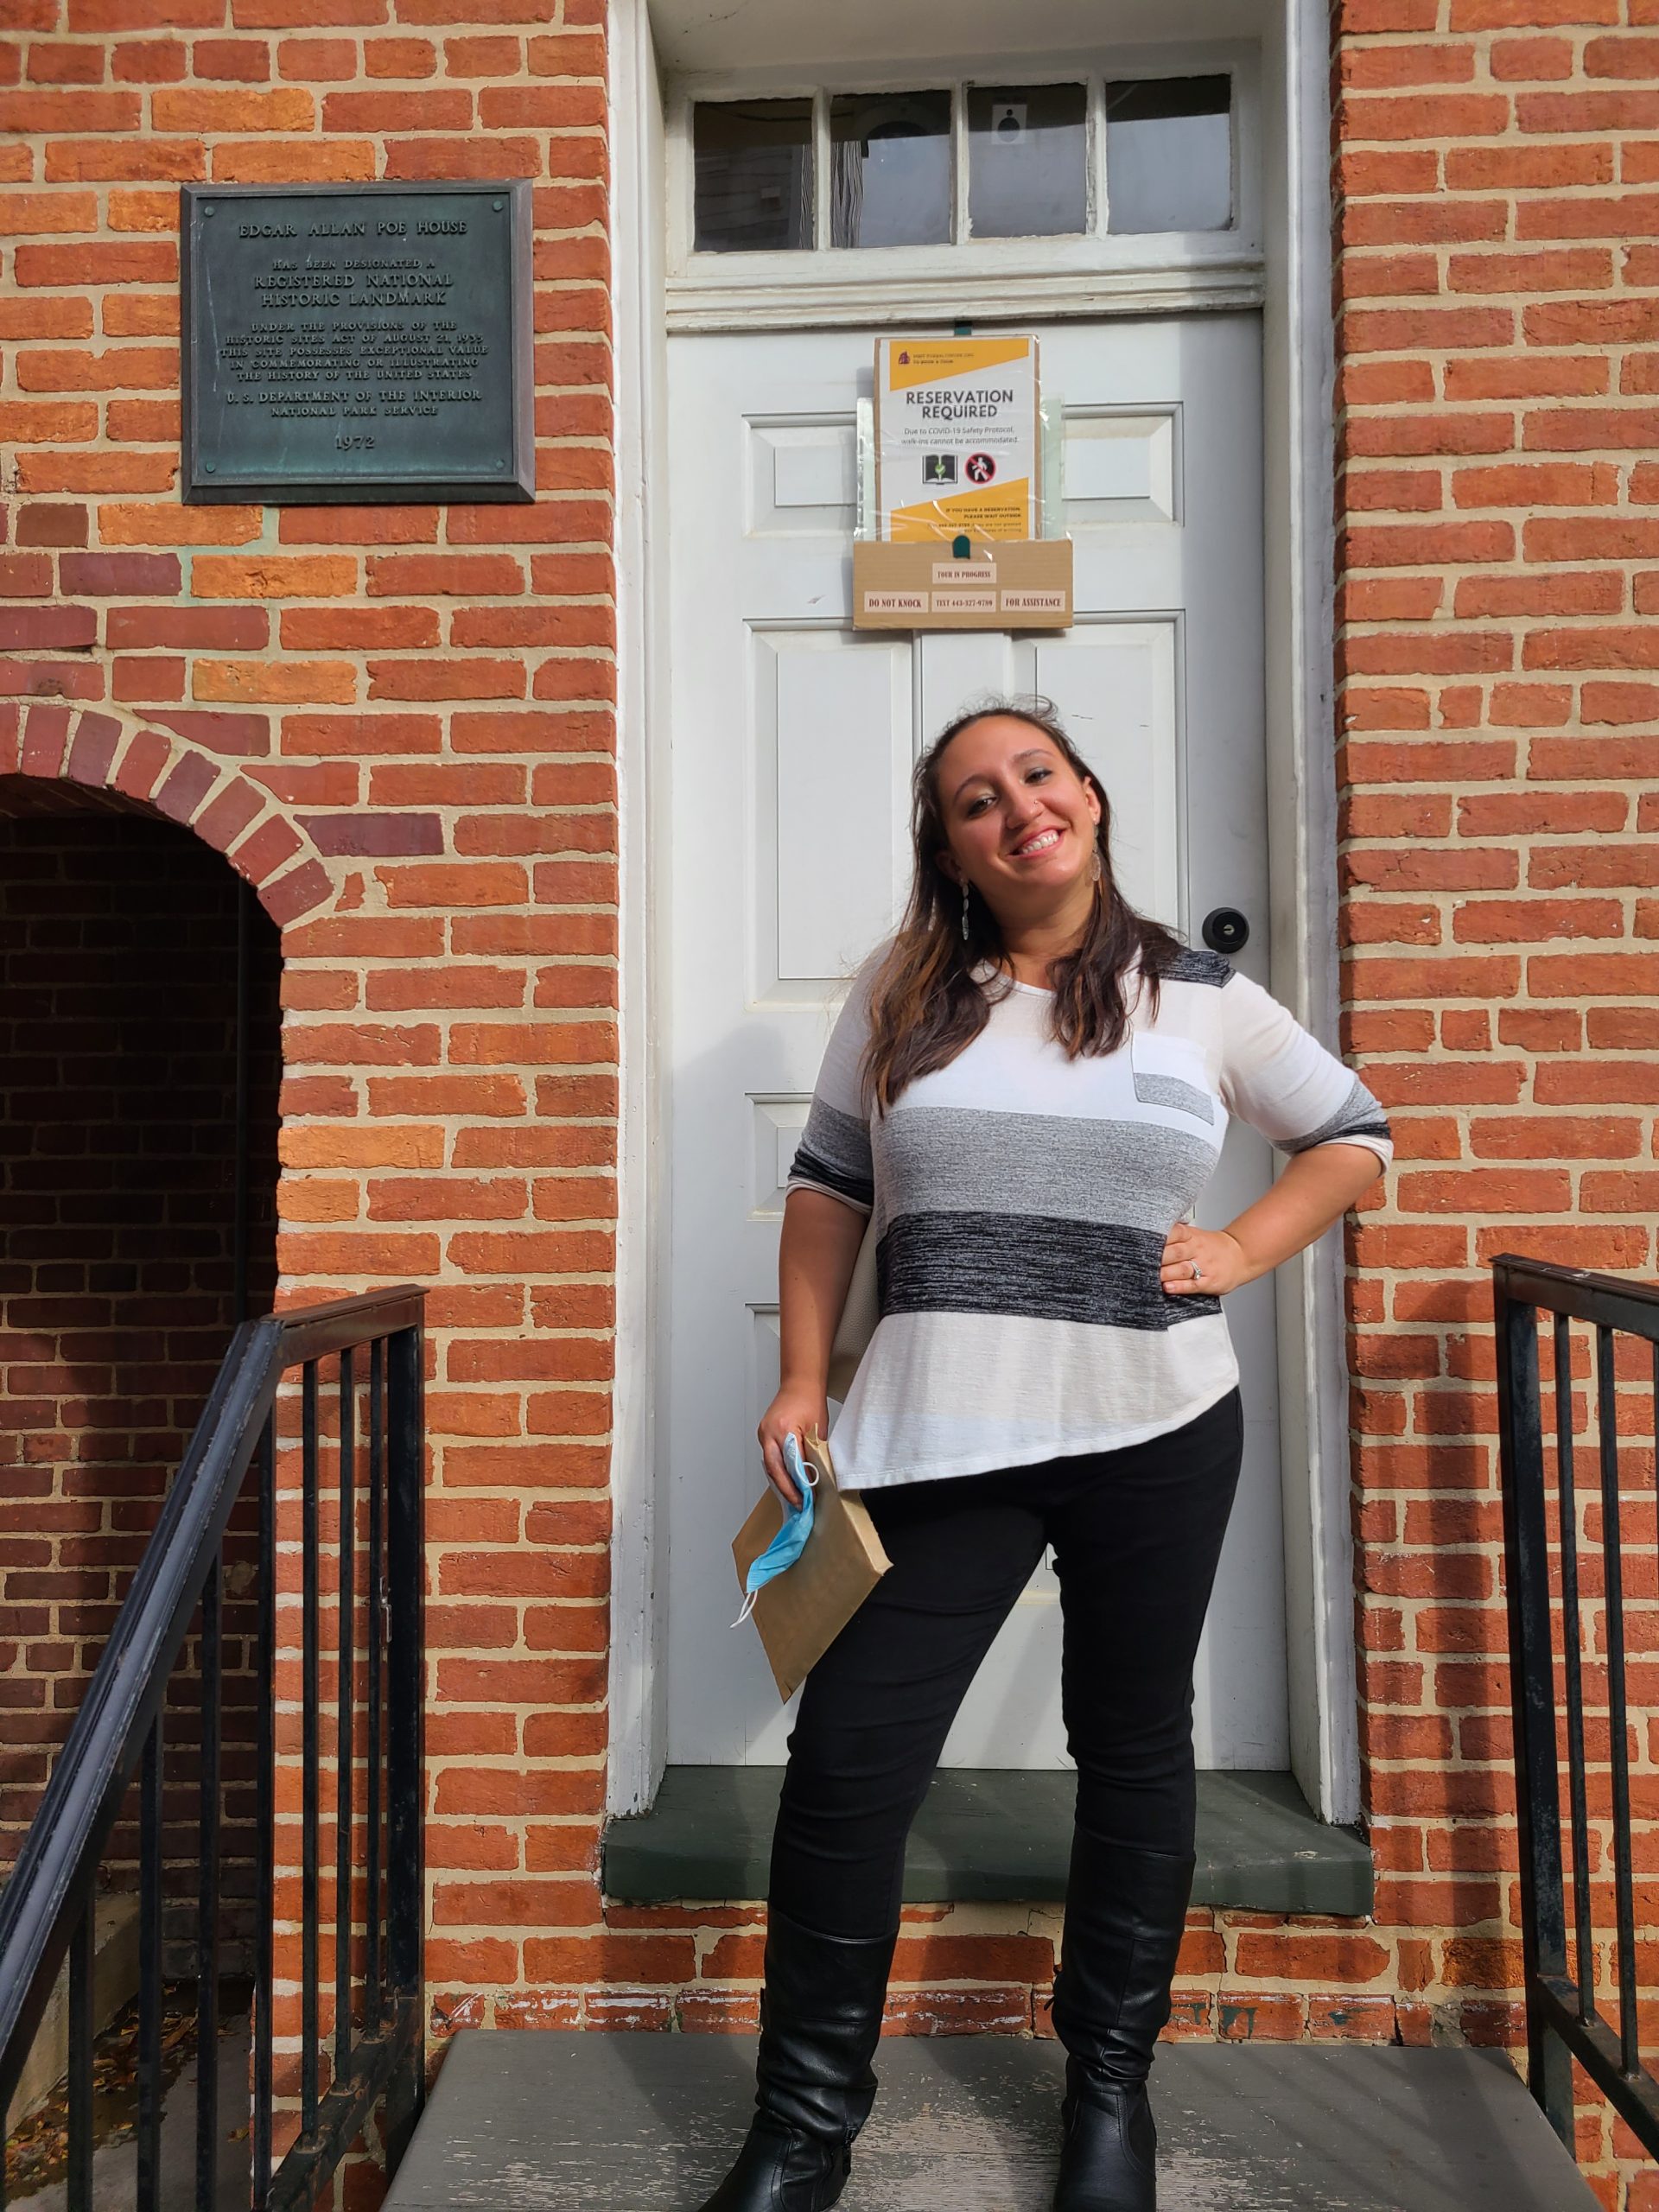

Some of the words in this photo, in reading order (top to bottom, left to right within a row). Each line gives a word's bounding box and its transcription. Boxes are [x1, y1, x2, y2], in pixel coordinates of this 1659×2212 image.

[239, 224, 297, 238] EDGAR
[308, 222, 365, 236] ALLAN
[377, 221, 407, 235] POE
[416, 220, 467, 234] HOUSE
[273, 260, 298, 270] HAS
[306, 260, 336, 270] BEEN
[426, 258, 435, 269] A
[255, 275, 355, 289] REGISTERED
[366, 272, 454, 288] NATIONAL
[262, 293, 340, 307] HISTORIC
[349, 290, 446, 306] LANDMARK
[251, 322, 295, 333] UNDER
[302, 321, 325, 332] THE
[333, 321, 404, 332] PROVISIONS
[411, 321, 427, 330] OF
[434, 321, 457, 330] THE
[226, 335, 283, 346] HISTORIC
[292, 334, 325, 343] SITES
[332, 334, 355, 344] ACT
[362, 334, 376, 342] OF
[384, 334, 430, 343] AUGUST
[220, 347, 248, 358] THIS
[256, 347, 282, 358] SITE
[290, 346, 353, 356] POSSESSES
[359, 346, 443, 355] EXCEPTIONAL
[449, 346, 488, 355] VALUE
[230, 361, 243, 370] IN
[251, 359, 360, 369] COMMEMORATING
[367, 359, 384, 367] OR
[390, 358, 480, 367] ILLUSTRATING
[238, 372, 261, 381] THE
[268, 372, 319, 381] HISTORY
[325, 371, 340, 380] OF
[346, 371, 370, 380] THE
[377, 370, 423, 379] UNITED
[227, 393, 238, 404] U.
[243, 393, 253, 404] S.
[259, 391, 349, 403] DEPARTMENT
[355, 391, 372, 402] OF
[379, 391, 406, 402] THE
[413, 390, 482, 401] INTERIOR
[906, 390, 1014, 404] RESERVATION
[271, 407, 335, 417] NATIONAL
[343, 407, 377, 416] PARK
[385, 406, 438, 416] SERVICE
[922, 404, 998, 421] REQUIRED
[962, 426, 983, 435] Safety
[335, 435, 375, 450] 1972
[868, 599, 880, 607] DO
[881, 599, 896, 607] NOT
[898, 599, 922, 607] KNOCK
